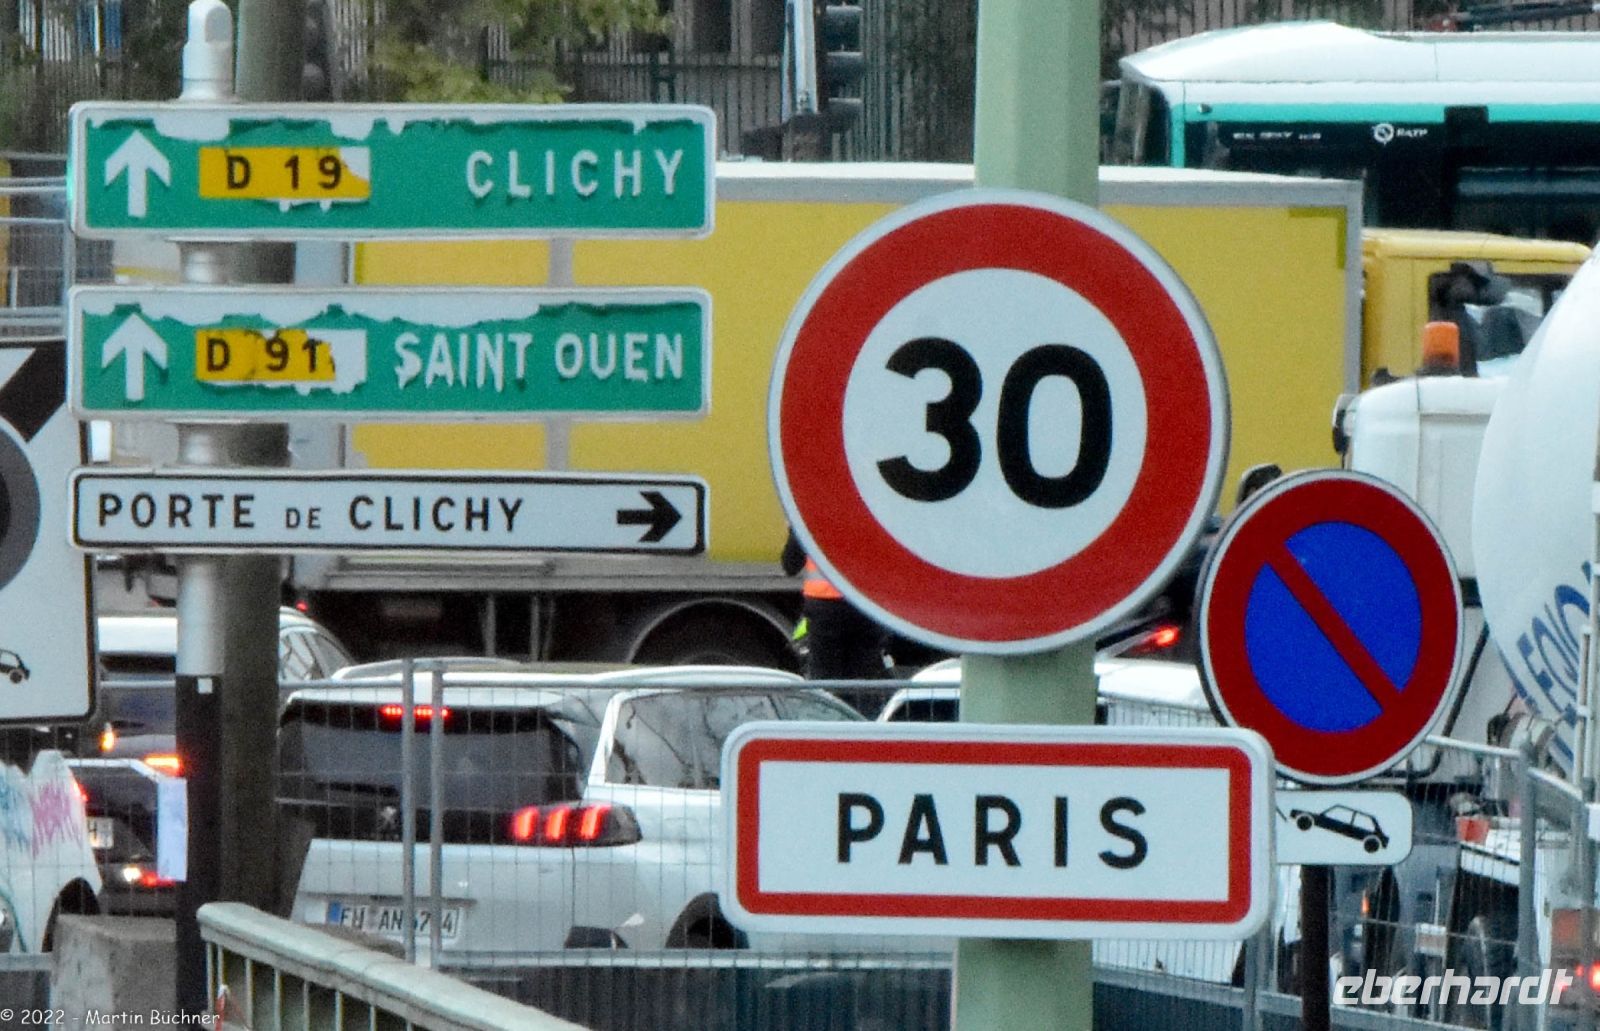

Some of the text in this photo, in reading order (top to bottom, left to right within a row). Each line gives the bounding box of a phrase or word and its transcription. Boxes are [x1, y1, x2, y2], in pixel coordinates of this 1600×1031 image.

[226, 155, 342, 190] D 19
[465, 149, 684, 199] CLICHY
[206, 336, 337, 374] D 91
[394, 332, 683, 393] SAINT OUEN
[876, 336, 1114, 509] 30
[98, 492, 523, 533] PORTE DE CLICHY
[837, 792, 1149, 870] PARIS
